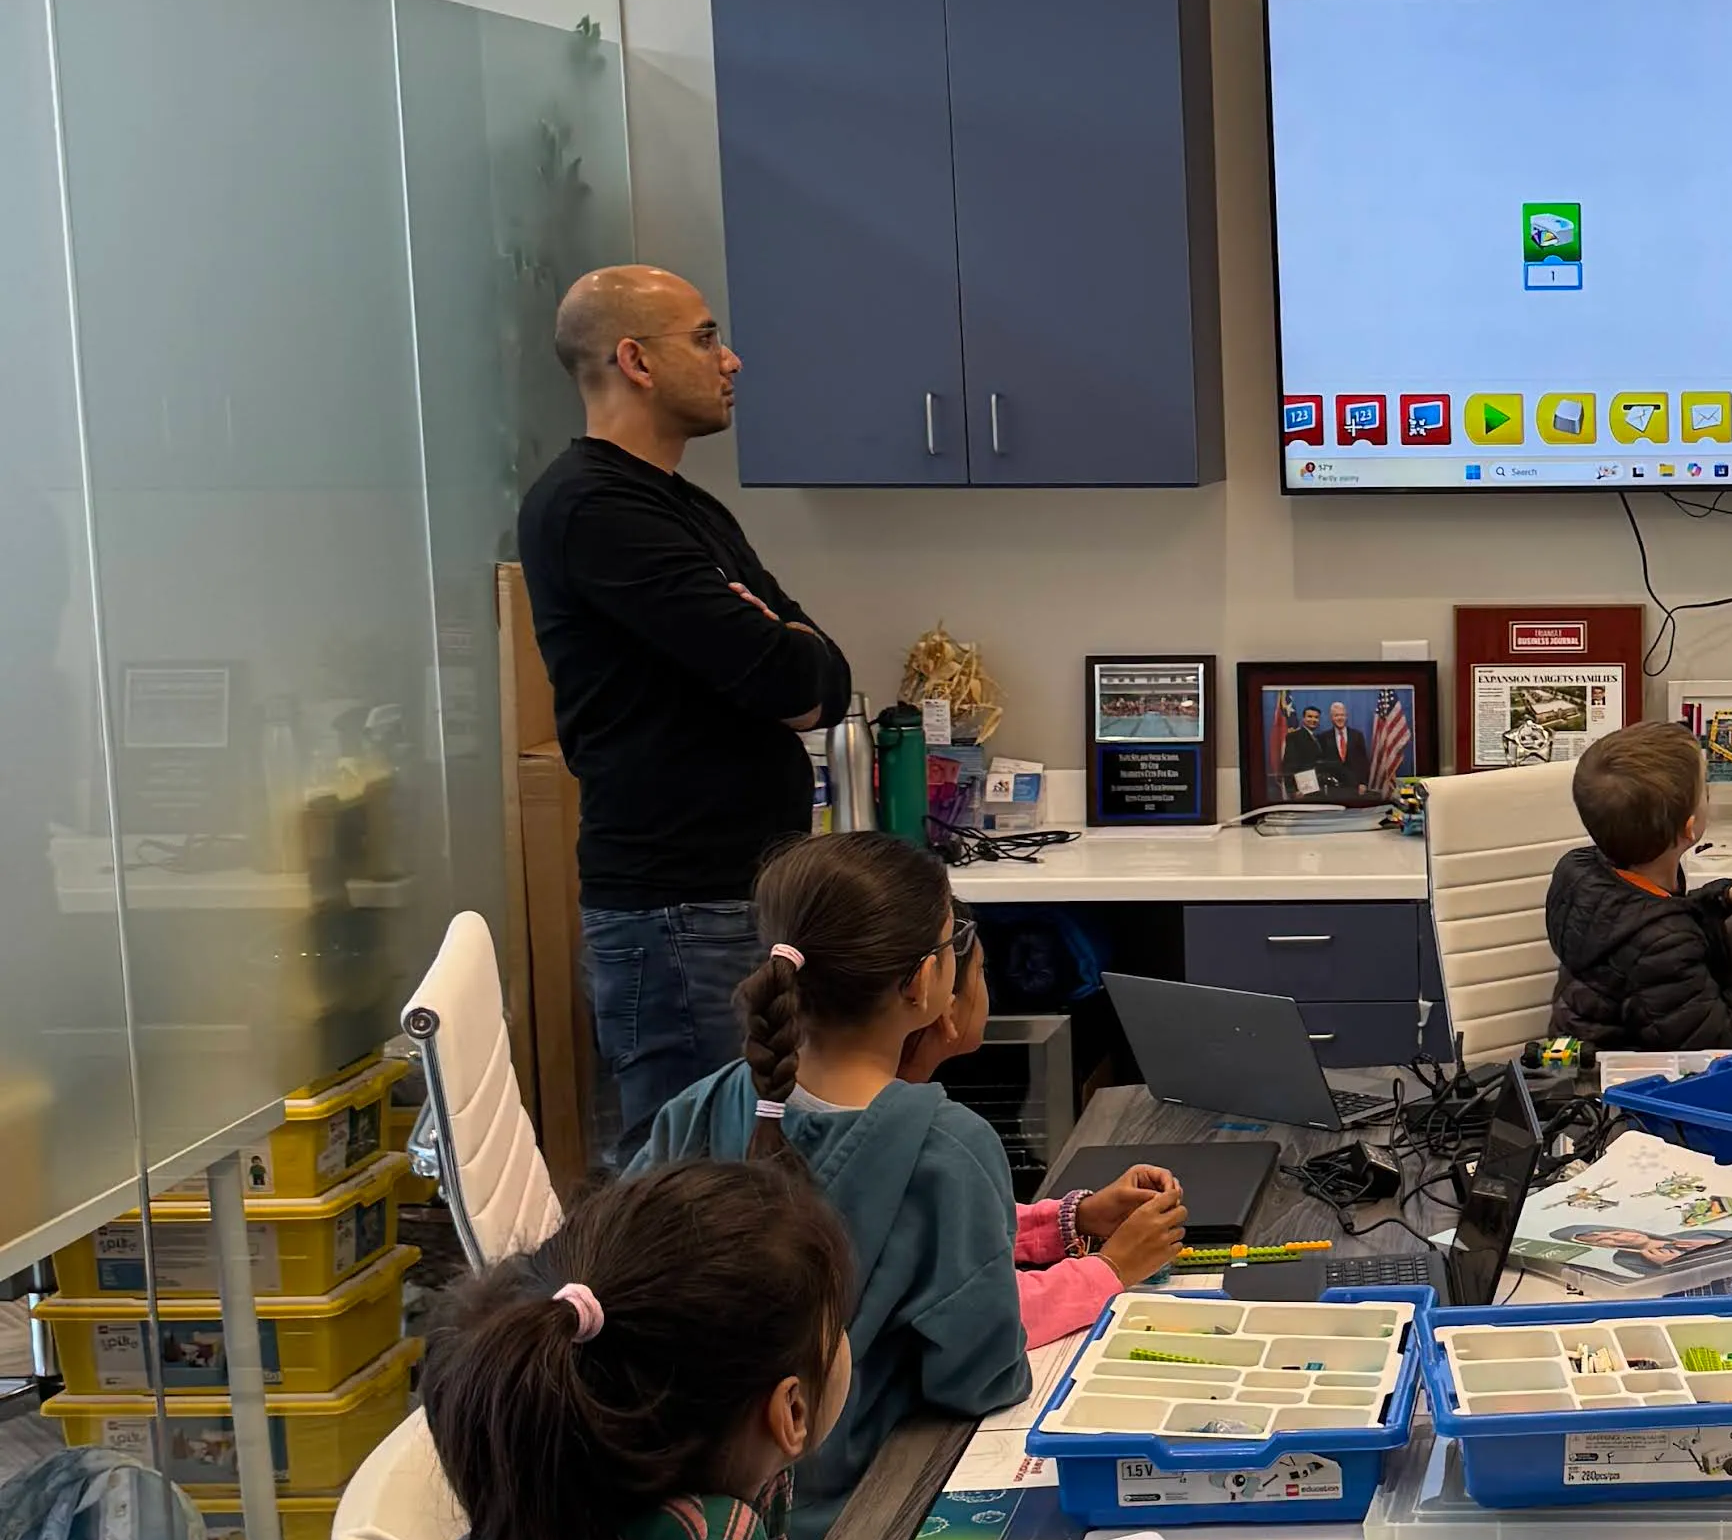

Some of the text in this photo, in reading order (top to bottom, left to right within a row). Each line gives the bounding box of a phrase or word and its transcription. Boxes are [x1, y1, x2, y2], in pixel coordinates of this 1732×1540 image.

[1290, 409, 1309, 422] 123
[1354, 408, 1373, 422] 123
[1517, 637, 1579, 645] BUSINESS JOURNAL
[1478, 674, 1618, 683] EXPANSION TARGETS FAMILIES
[1126, 1464, 1143, 1478] 1.5
[1301, 1484, 1339, 1493] education
